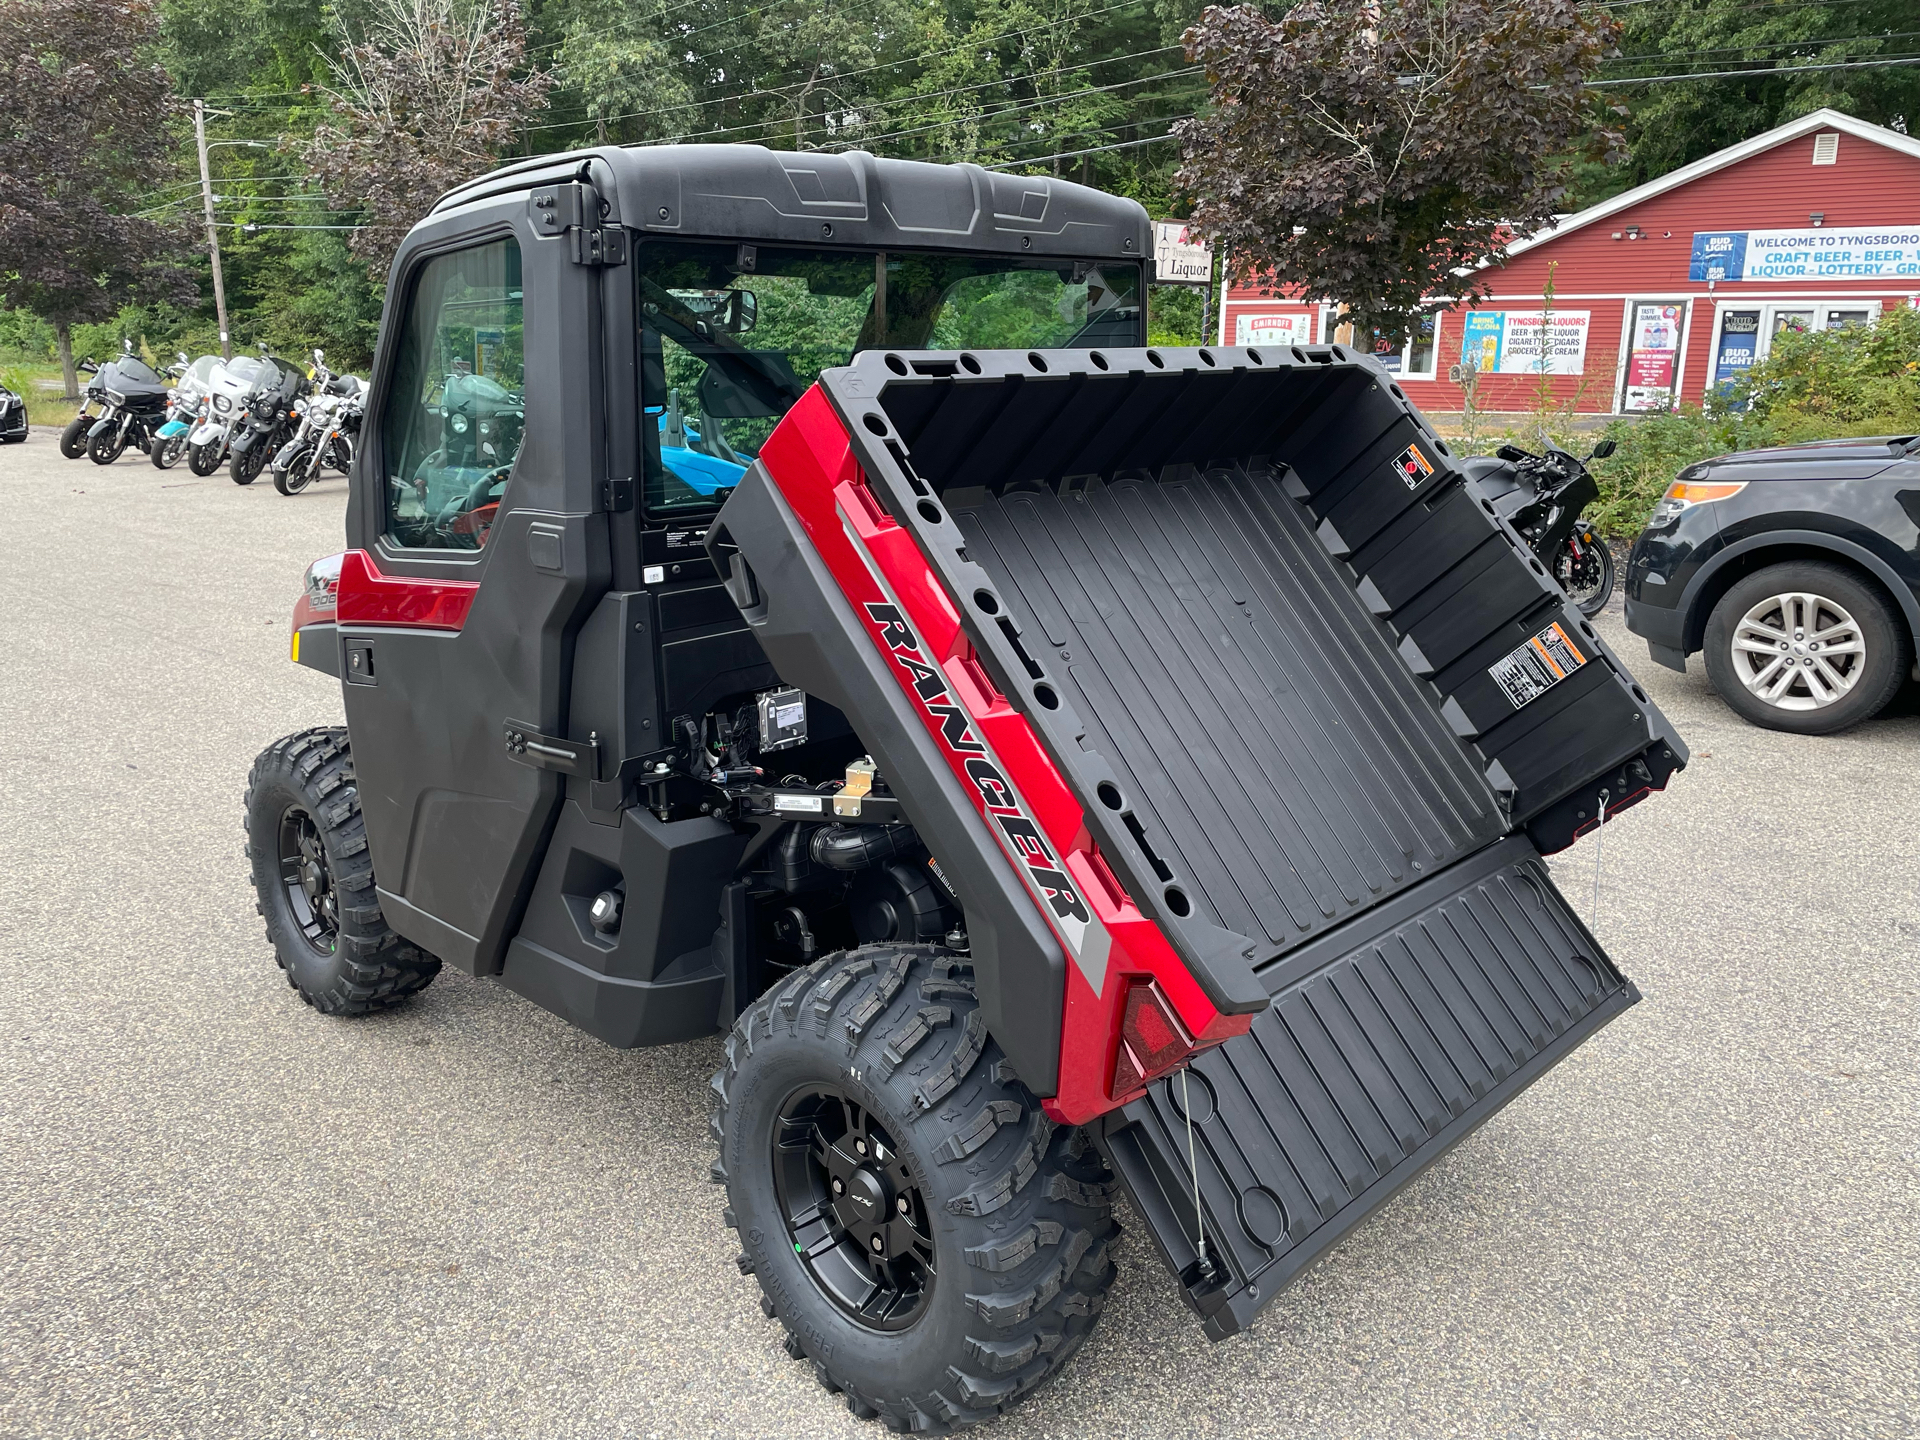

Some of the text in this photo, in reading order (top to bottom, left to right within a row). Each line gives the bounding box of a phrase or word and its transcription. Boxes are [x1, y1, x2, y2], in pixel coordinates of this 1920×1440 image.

[1710, 237, 1731, 245] BUD
[1754, 234, 1920, 248] WELCOME TO TYNGSBORO
[1765, 251, 1811, 263] CRAFT
[1814, 251, 1852, 262] BEER
[1864, 250, 1904, 261] BEER
[1170, 260, 1208, 278] Liquor
[1751, 265, 1806, 278] LIQUOR
[1818, 264, 1884, 275] LOTTERY
[1896, 263, 1920, 274] GR
[1254, 318, 1290, 329] SMIRNOFF
[1553, 317, 1586, 326] LIQUORS
[1511, 328, 1528, 336] BEER
[1554, 329, 1580, 337] LIQUOR
[1554, 338, 1580, 346] CIGARS
[1508, 347, 1539, 355] GROCERY
[1555, 347, 1579, 355] CREAM
[1725, 348, 1750, 357] BUD
[1719, 356, 1754, 365] LIGHT
[862, 601, 1092, 926] RANGER
